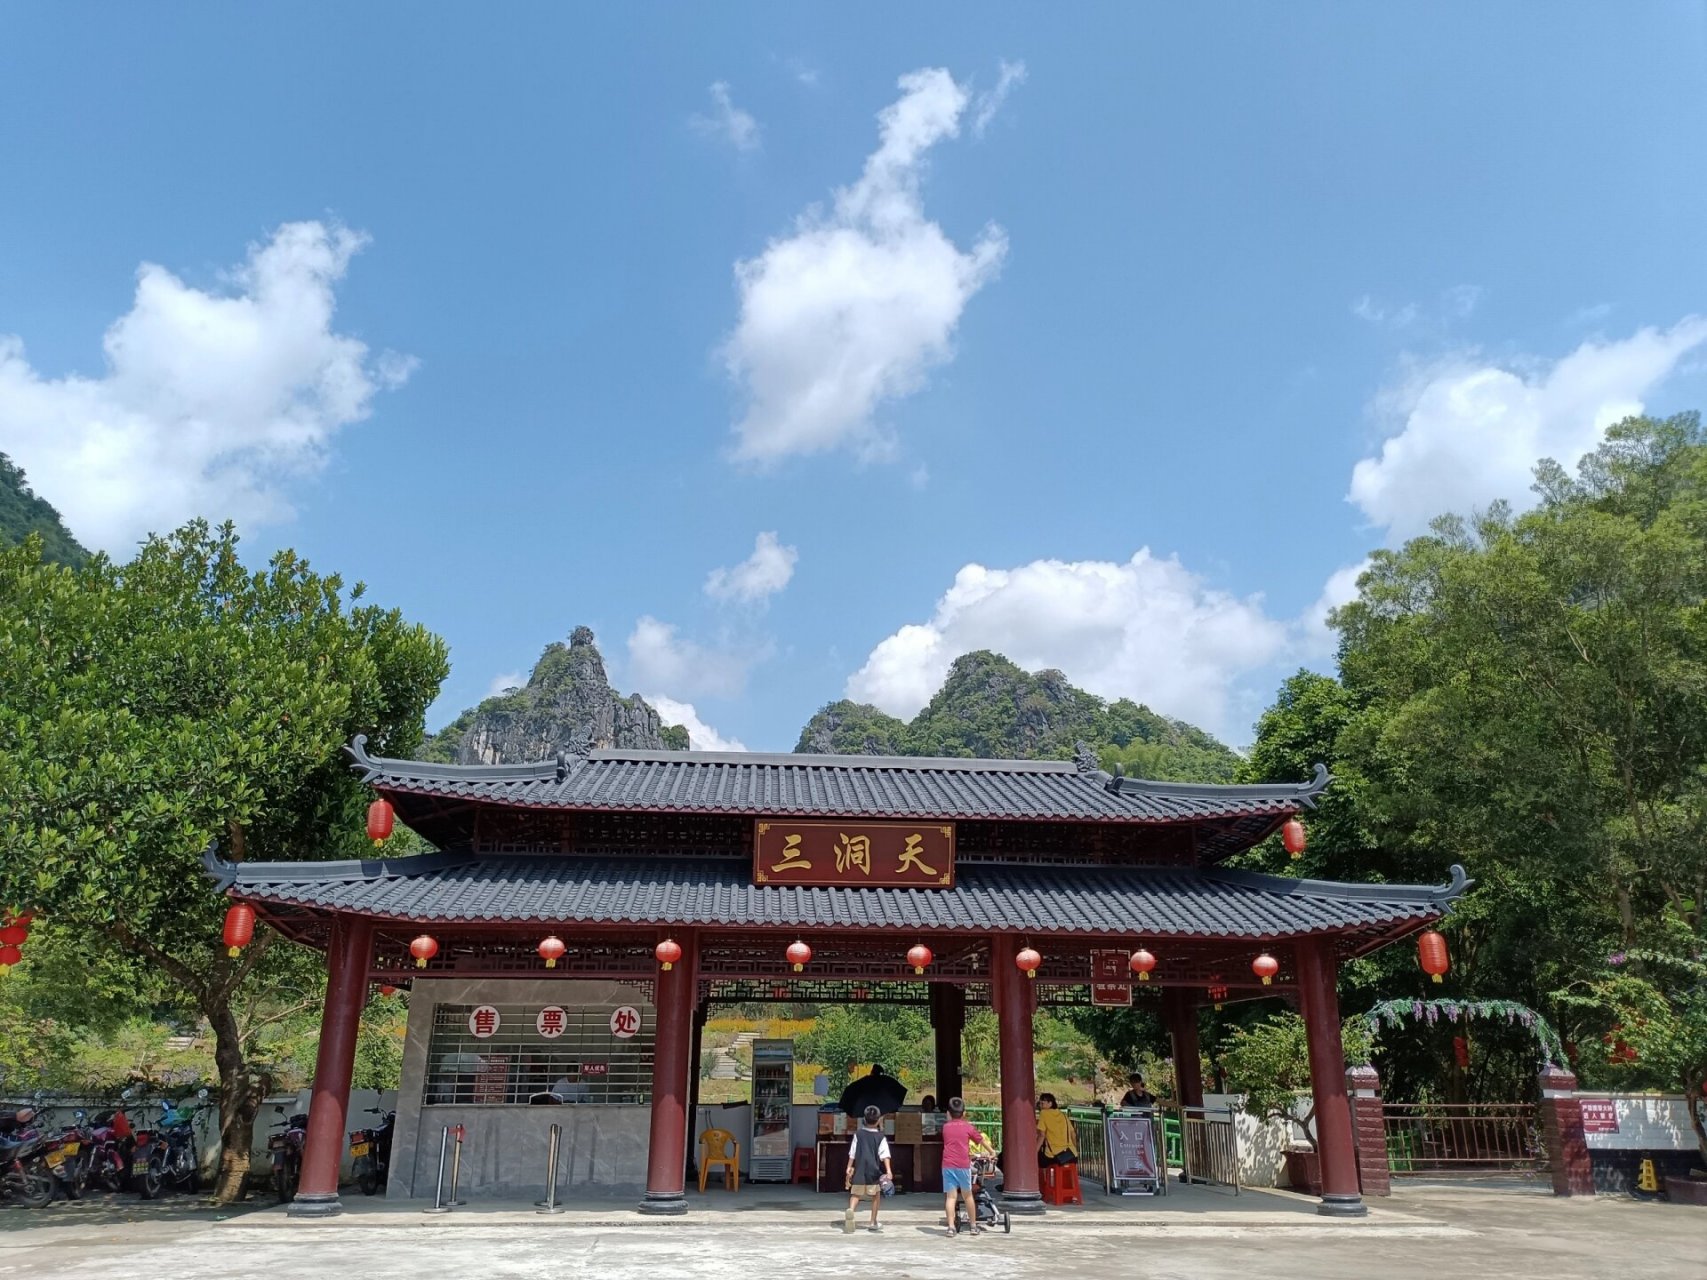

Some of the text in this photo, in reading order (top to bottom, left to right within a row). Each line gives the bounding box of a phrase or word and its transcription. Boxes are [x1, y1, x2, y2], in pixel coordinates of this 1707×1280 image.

[771, 832, 938, 876] 三洞天
[473, 1009, 637, 1035] 售票处
[1120, 1131, 1143, 1141] 入口
